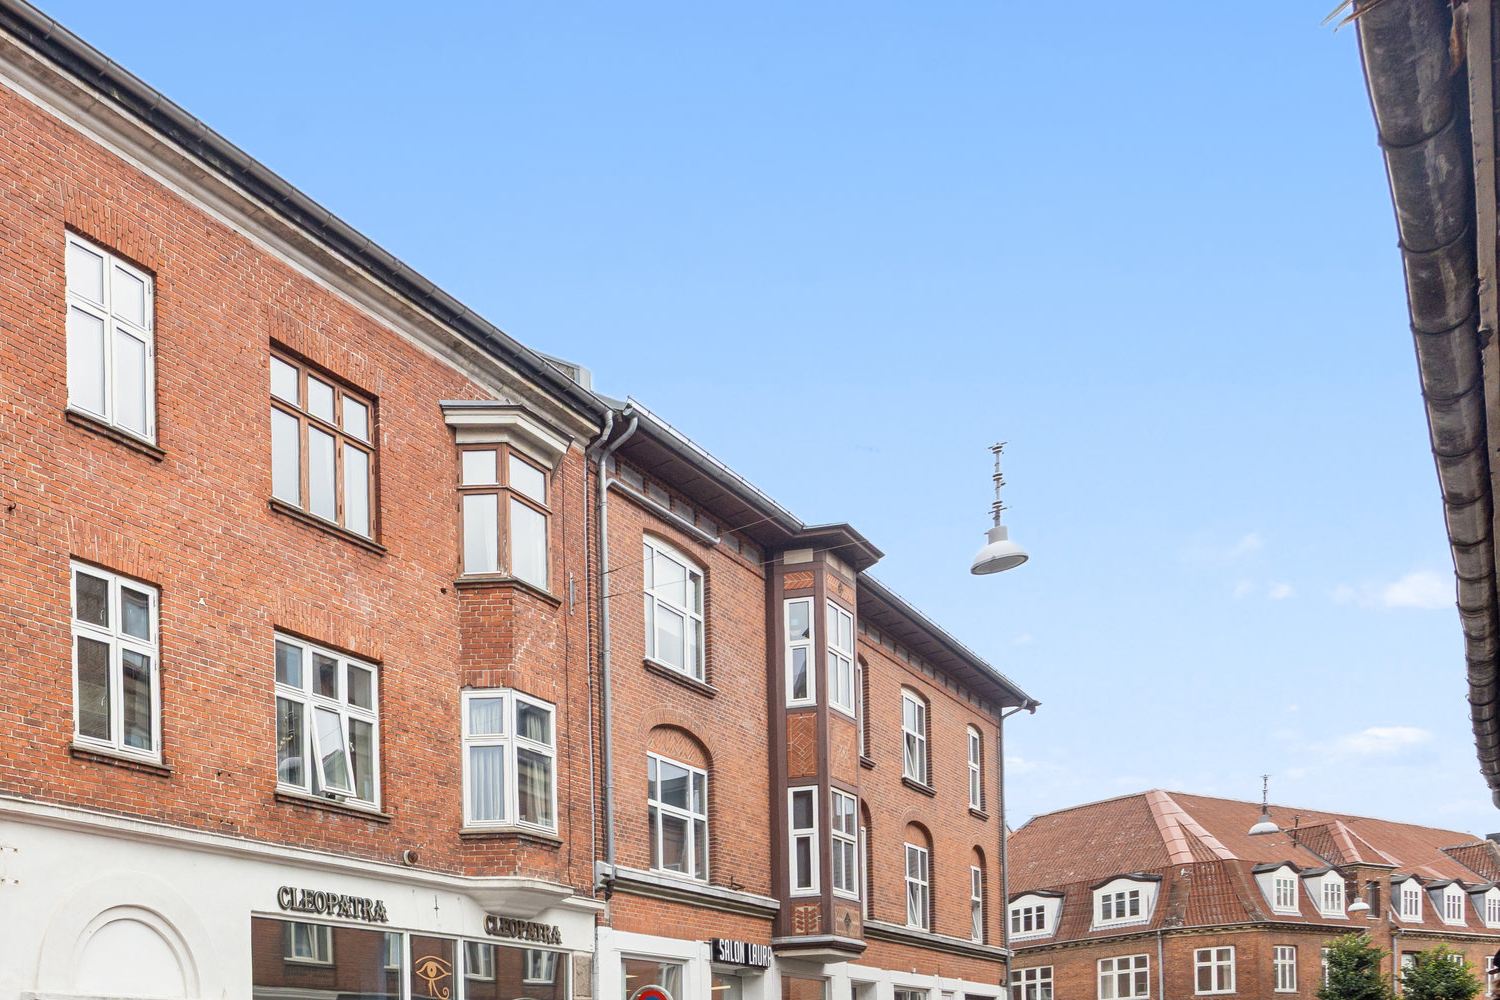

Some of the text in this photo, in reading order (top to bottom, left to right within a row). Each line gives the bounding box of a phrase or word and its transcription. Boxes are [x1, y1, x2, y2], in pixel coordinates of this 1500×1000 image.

[277, 885, 389, 923] CLEOPATRA
[483, 914, 563, 945] CLEOPATRA
[719, 938, 772, 967] SALON LAURA
